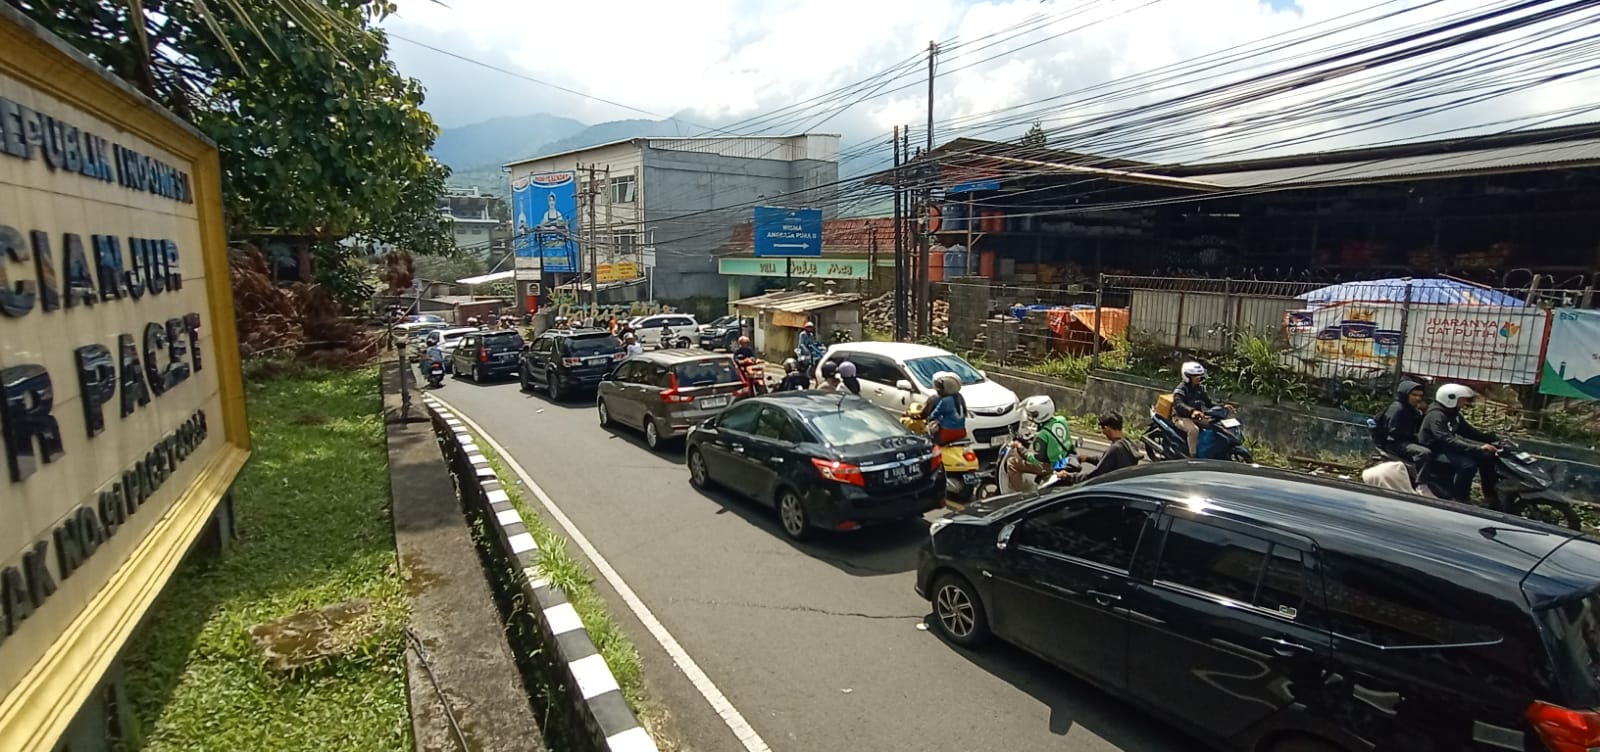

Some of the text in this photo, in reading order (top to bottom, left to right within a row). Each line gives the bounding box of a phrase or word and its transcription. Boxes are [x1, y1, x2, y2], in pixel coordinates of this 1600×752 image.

[0, 96, 112, 182] EPUBLIK
[0, 225, 183, 318] CIANJUR
[1427, 317, 1498, 329] JUARANYA
[1427, 326, 1496, 339] CAT PUTIH
[75, 312, 202, 439] PACET
[0, 540, 58, 648] AK
